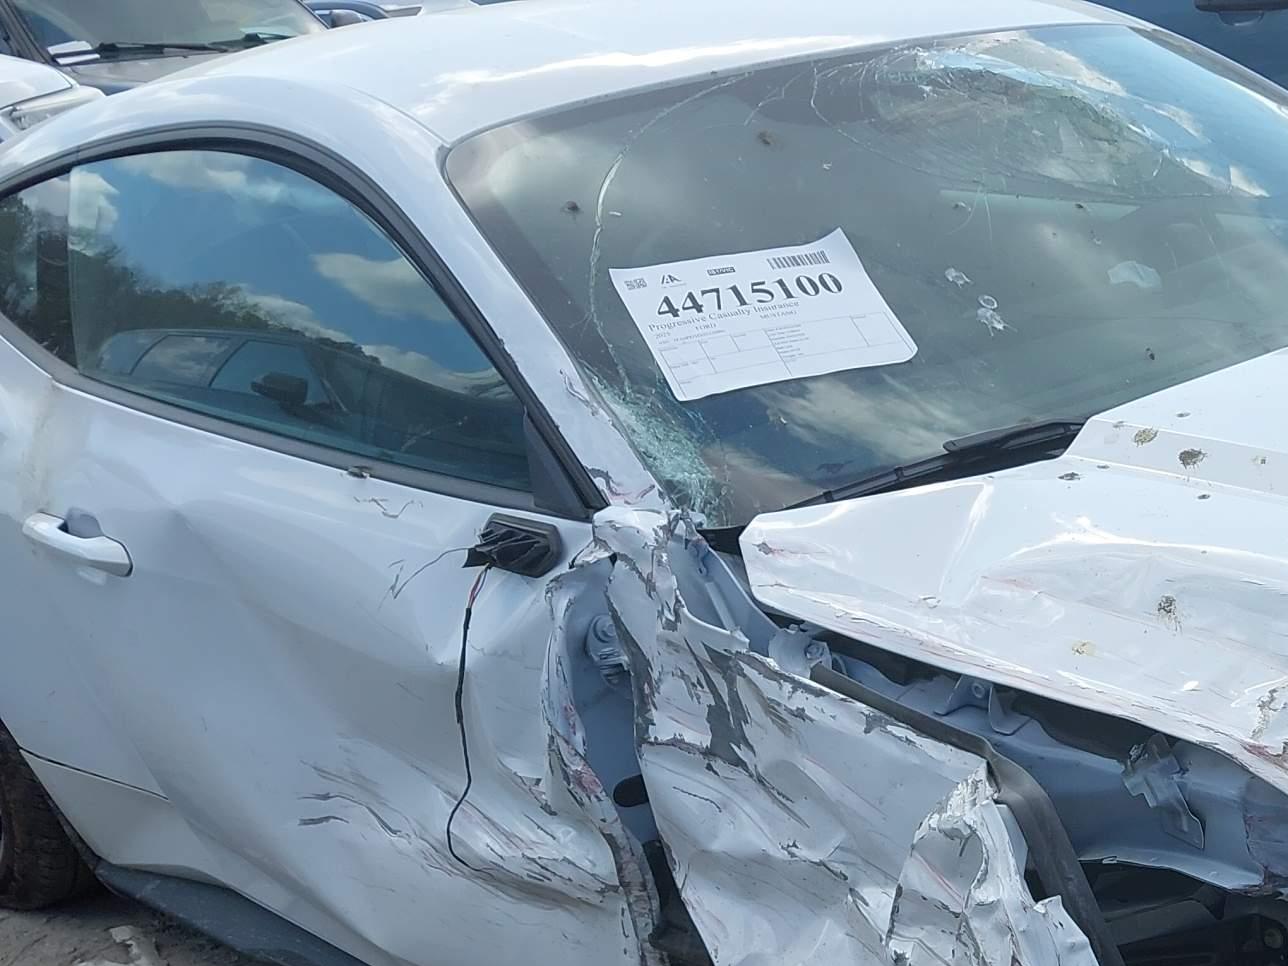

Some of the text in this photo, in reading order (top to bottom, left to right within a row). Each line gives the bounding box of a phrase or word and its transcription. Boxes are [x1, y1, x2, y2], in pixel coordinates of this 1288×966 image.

[657, 272, 843, 318] 44715100
[648, 301, 799, 331] Progressive Casualty Insurance
